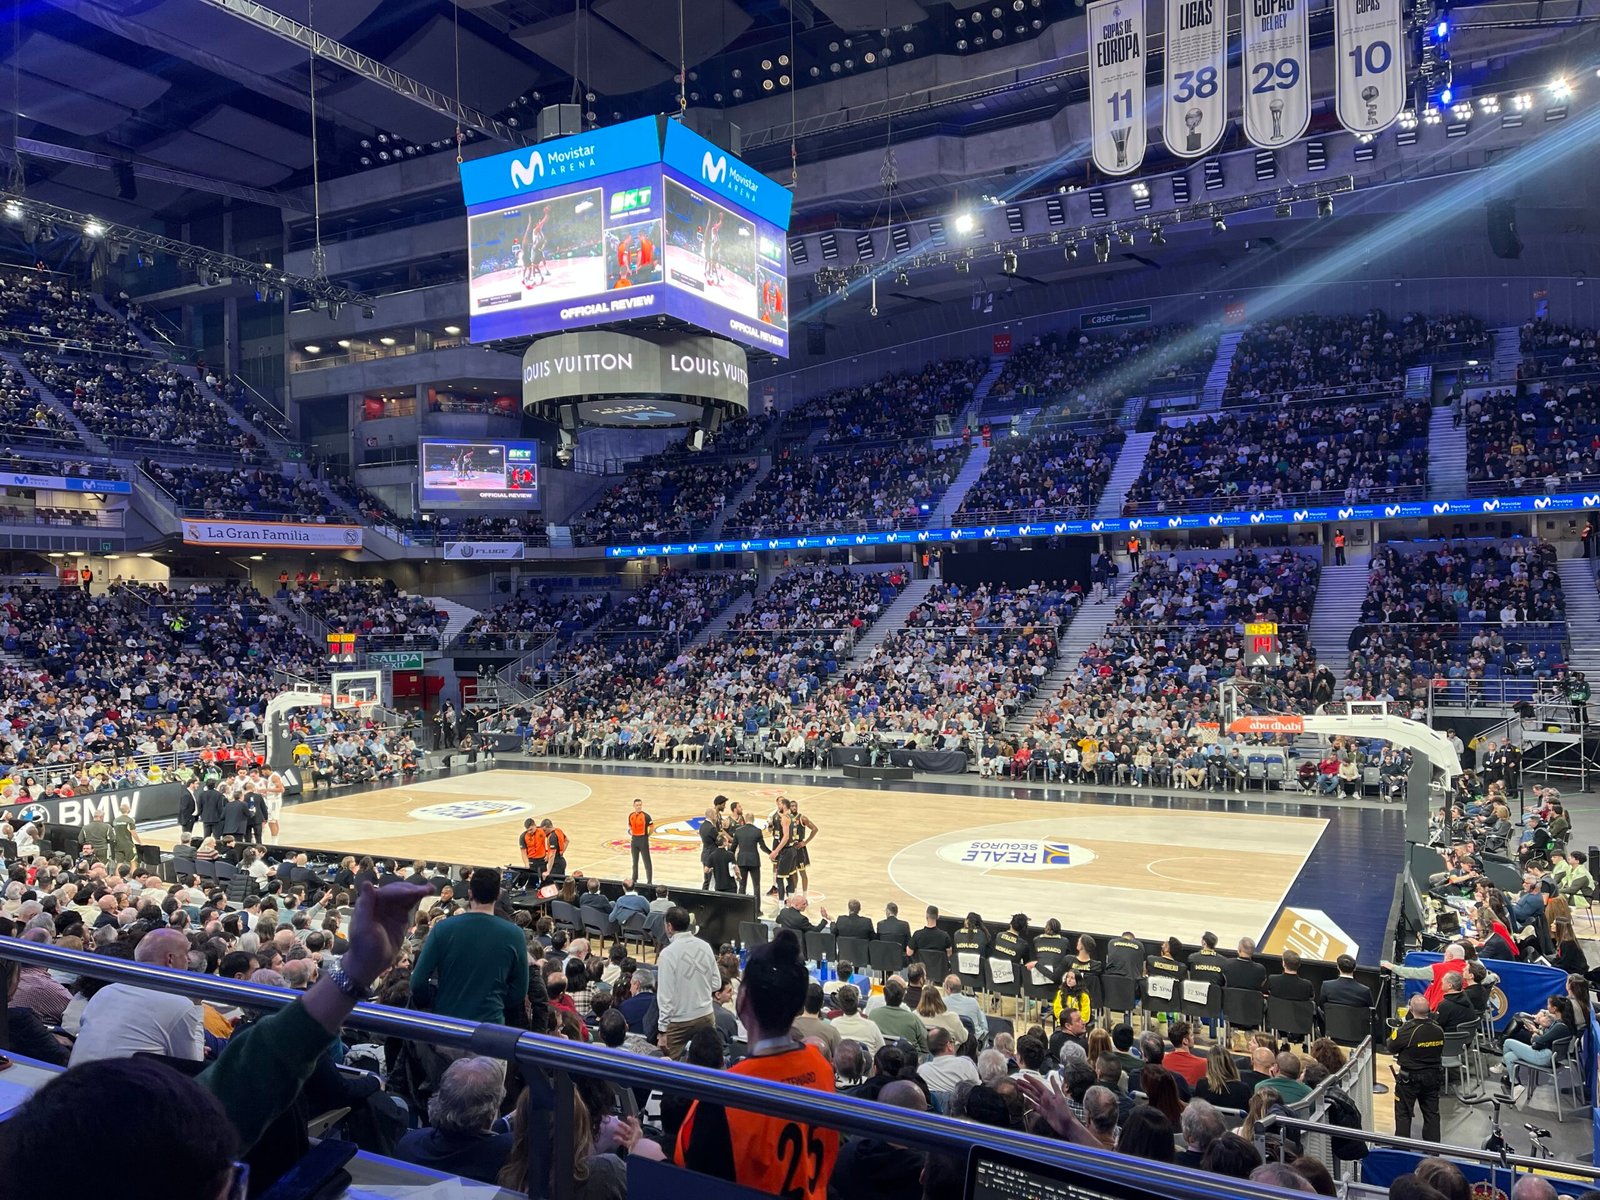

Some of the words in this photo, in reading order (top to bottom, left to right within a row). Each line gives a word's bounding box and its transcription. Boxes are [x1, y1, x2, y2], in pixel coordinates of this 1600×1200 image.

[1179, 0, 1213, 31] LIGAS
[1261, 16, 1274, 32] DEL
[1274, 13, 1287, 30] REY
[1102, 23, 1124, 40] COPAS
[1124, 18, 1132, 33] DE
[1097, 32, 1140, 68] EUROPA
[1348, 40, 1392, 78] 10
[1173, 66, 1218, 103] 38
[1252, 57, 1300, 95] 29
[1107, 88, 1133, 122] 11
[547, 144, 596, 165] Movistar
[550, 158, 596, 175] ARENA
[728, 166, 759, 192] Movistar
[727, 182, 756, 203] ARENA
[560, 303, 610, 320] OFFICIAL
[610, 294, 655, 311] REVIEW
[1091, 313, 1116, 324] caser
[729, 318, 761, 339] OFFICIAL
[760, 331, 784, 347] REVIEW
[523, 360, 551, 385] LOUIS
[554, 352, 633, 374] VUITTON
[670, 354, 720, 377] LOUIS
[207, 527, 224, 538] La
[226, 527, 260, 540] Gran
[262, 529, 310, 541] Familia
[1254, 636, 1272, 654] 14
[370, 653, 420, 664] SALIDA
[1250, 721, 1270, 730] abu
[1270, 721, 1301, 731] dhabi
[58, 790, 141, 827] BMW
[970, 841, 1039, 851] SEGUROS
[962, 850, 1037, 864] REALE
[995, 944, 1017, 956] MONACO
[1037, 946, 1062, 954] MONACO
[1113, 941, 1139, 950] MONACO
[1195, 964, 1222, 973] MONACO
[1152, 982, 1158, 991] 6
[777, 1121, 824, 1200] 25
